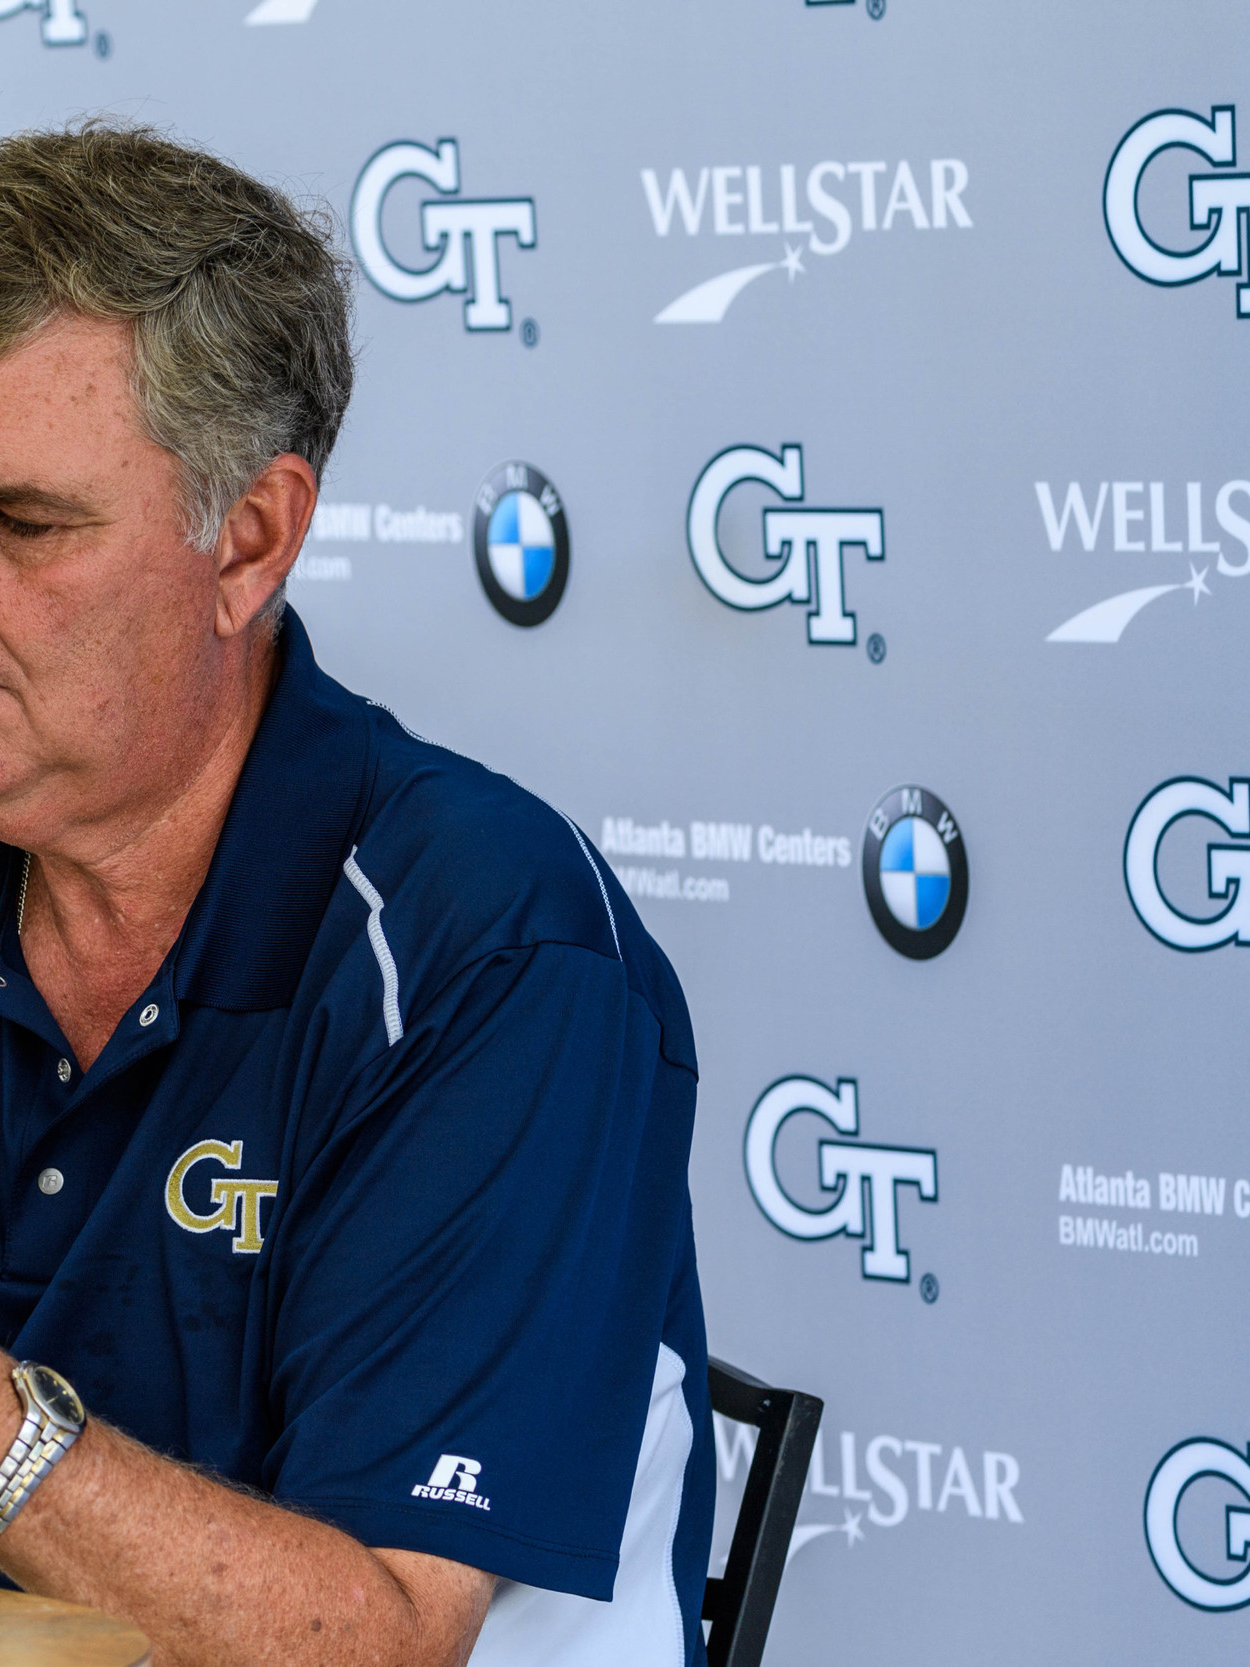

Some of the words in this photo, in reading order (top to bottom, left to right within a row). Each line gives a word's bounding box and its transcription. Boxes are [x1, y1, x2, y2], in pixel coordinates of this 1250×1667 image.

[350, 137, 536, 331] GT
[640, 159, 973, 255] WELLSTAR
[686, 442, 885, 646] GT
[1034, 479, 1250, 577] WELLS
[602, 817, 686, 858] Atlanta
[690, 821, 752, 862] BMW
[757, 825, 852, 867] Centers
[869, 787, 958, 843] BMW
[165, 1139, 279, 1254] GT
[744, 1073, 939, 1284] GT
[1059, 1163, 1152, 1210] Atlanta
[1158, 1172, 1226, 1216] BMW
[1059, 1215, 1199, 1258] BMWatl.com
[411, 1484, 491, 1511] RUSSELL
[713, 1408, 1025, 1526] WLLSTAR
[1143, 1436, 1250, 1612] G
